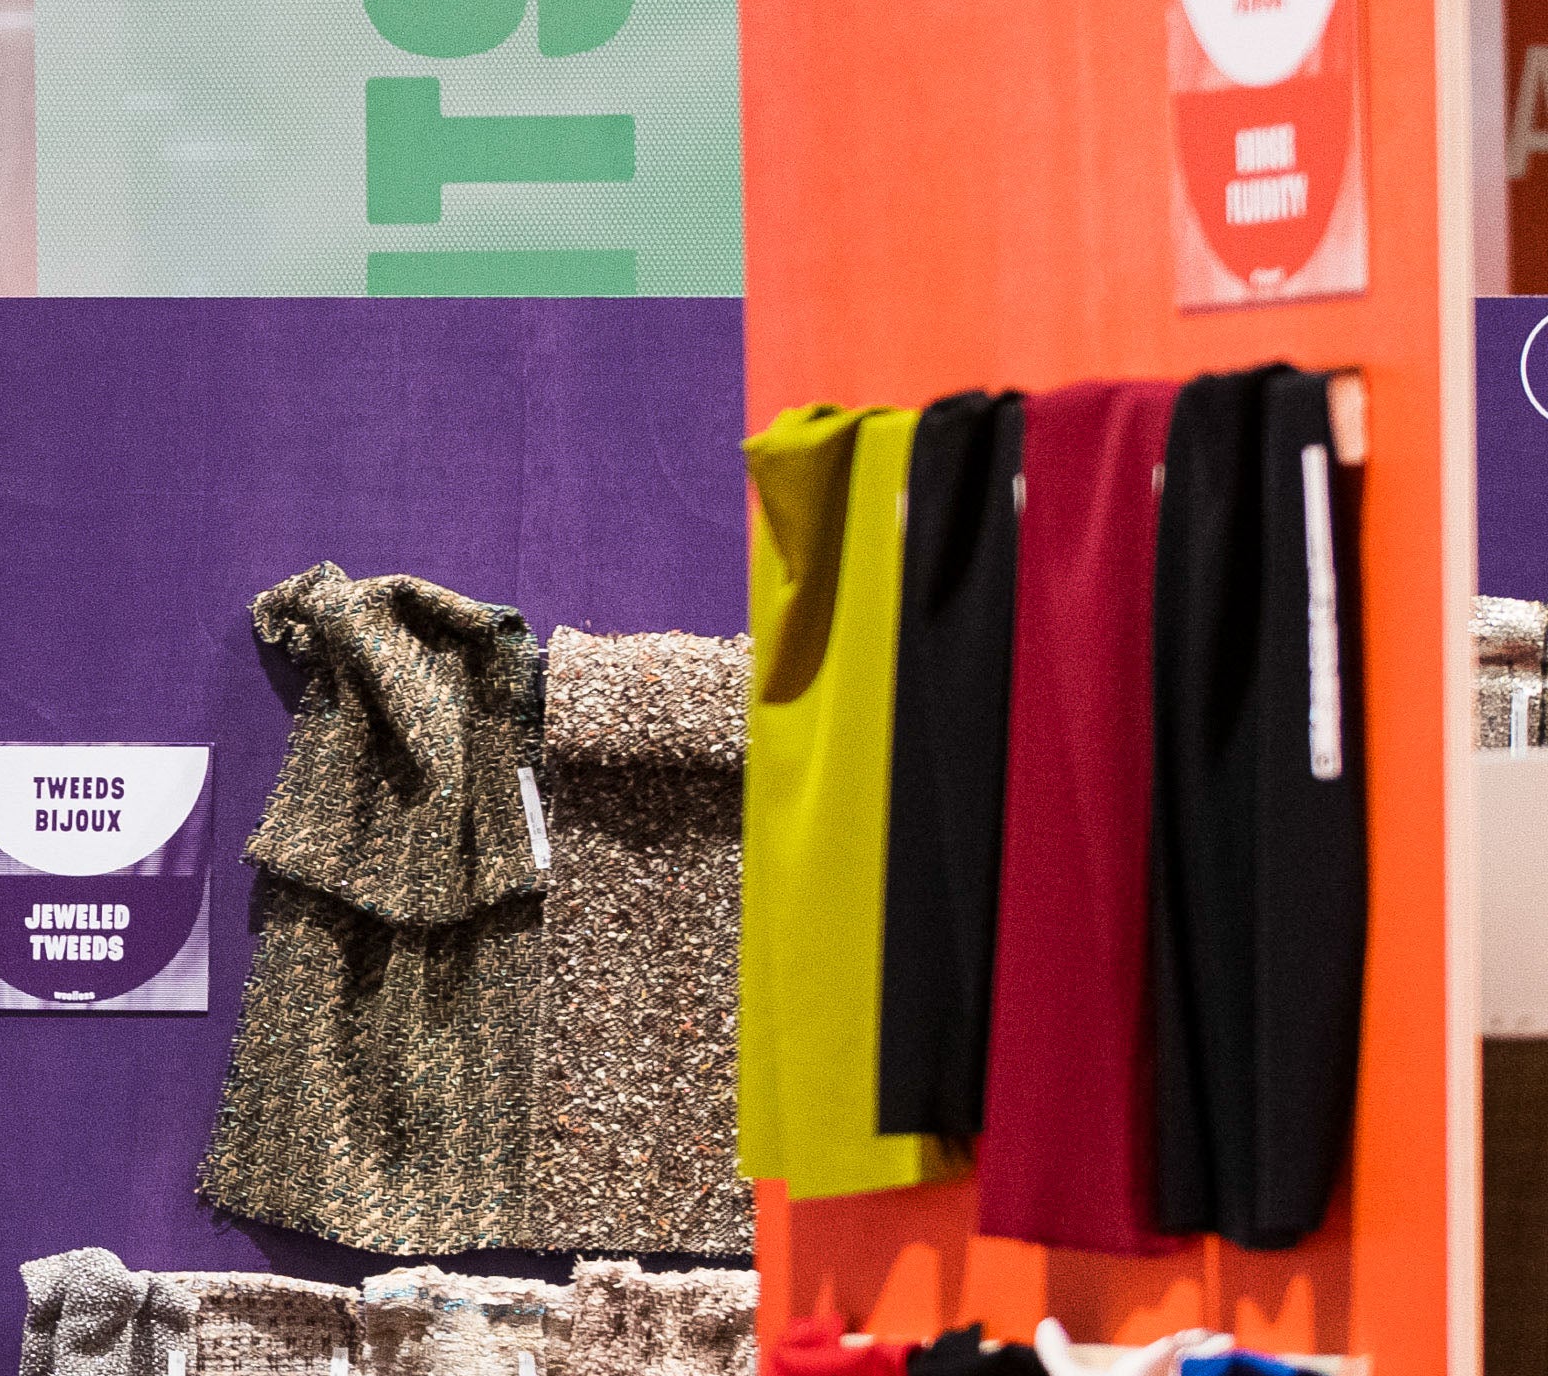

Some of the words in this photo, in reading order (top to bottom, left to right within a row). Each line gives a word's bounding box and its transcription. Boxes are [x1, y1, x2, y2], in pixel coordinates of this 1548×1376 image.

[33, 776, 125, 800] TWEEDS
[35, 809, 122, 832] BIJOUX
[24, 903, 130, 930] JEWELED
[29, 934, 124, 961] TWEEDS
